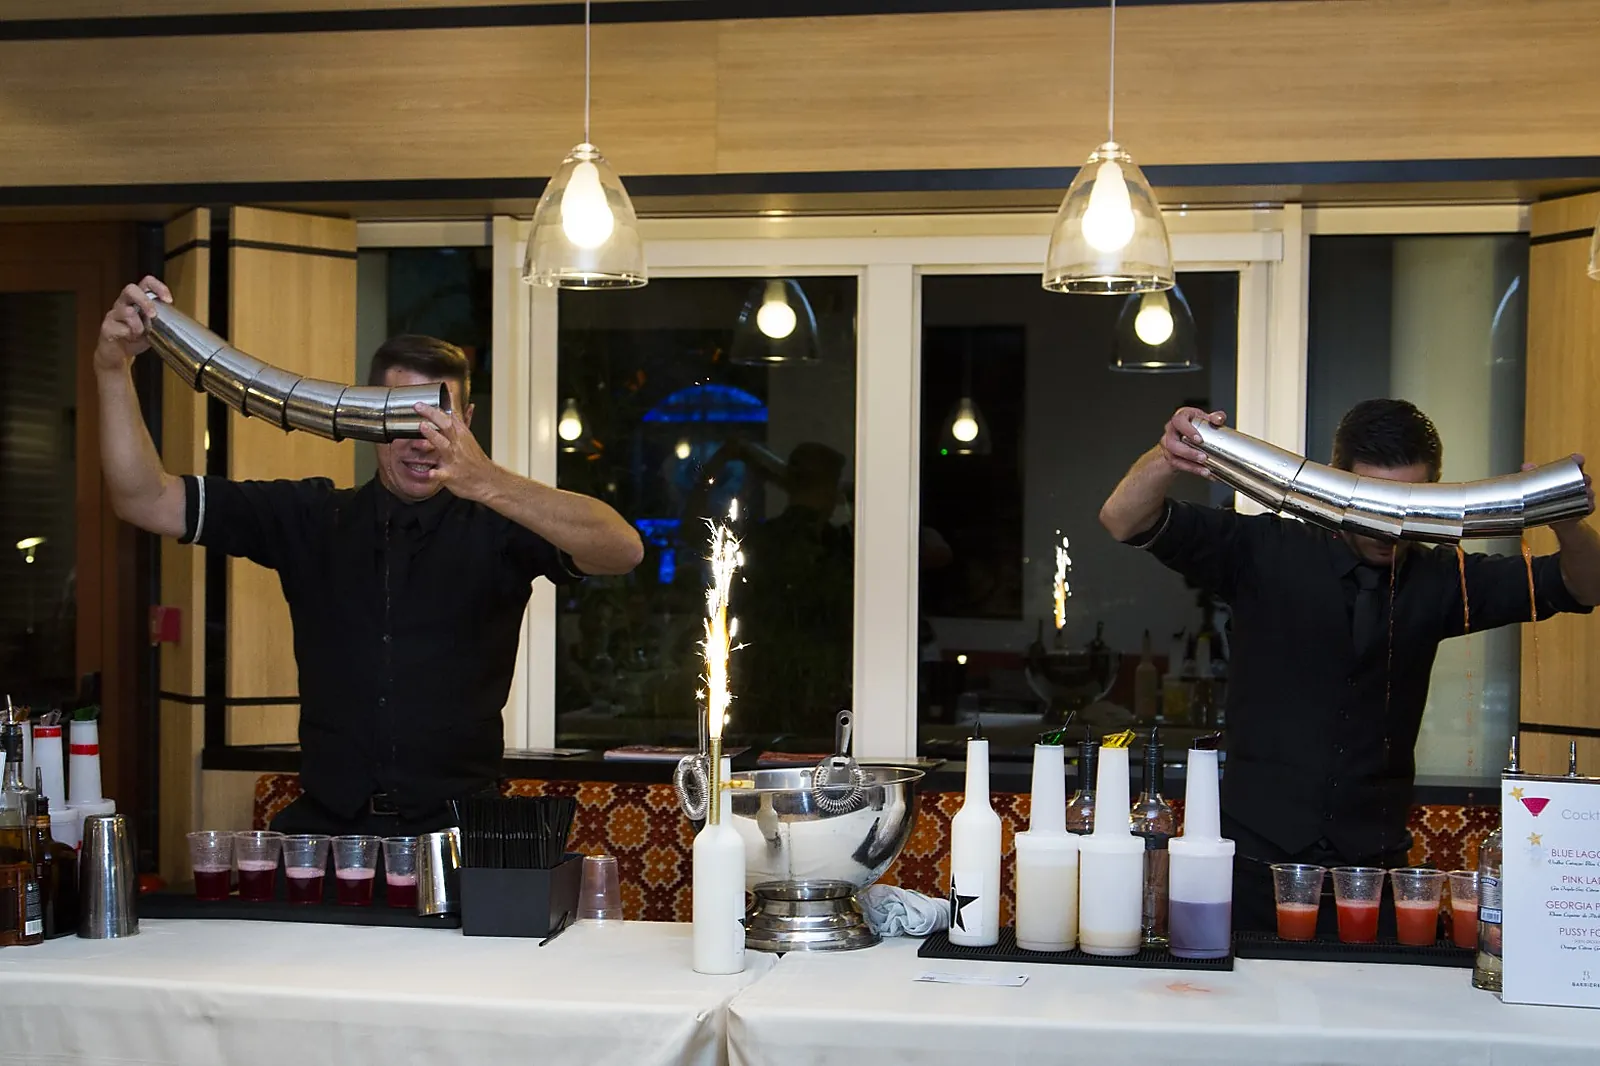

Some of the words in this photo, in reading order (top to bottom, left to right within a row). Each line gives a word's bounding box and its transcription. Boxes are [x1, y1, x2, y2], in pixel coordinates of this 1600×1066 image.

[1551, 849, 1573, 858] BLUE
[1562, 875, 1583, 884] PINK
[1545, 901, 1592, 910] GEORGIA
[1559, 927, 1587, 936] PUSSY
